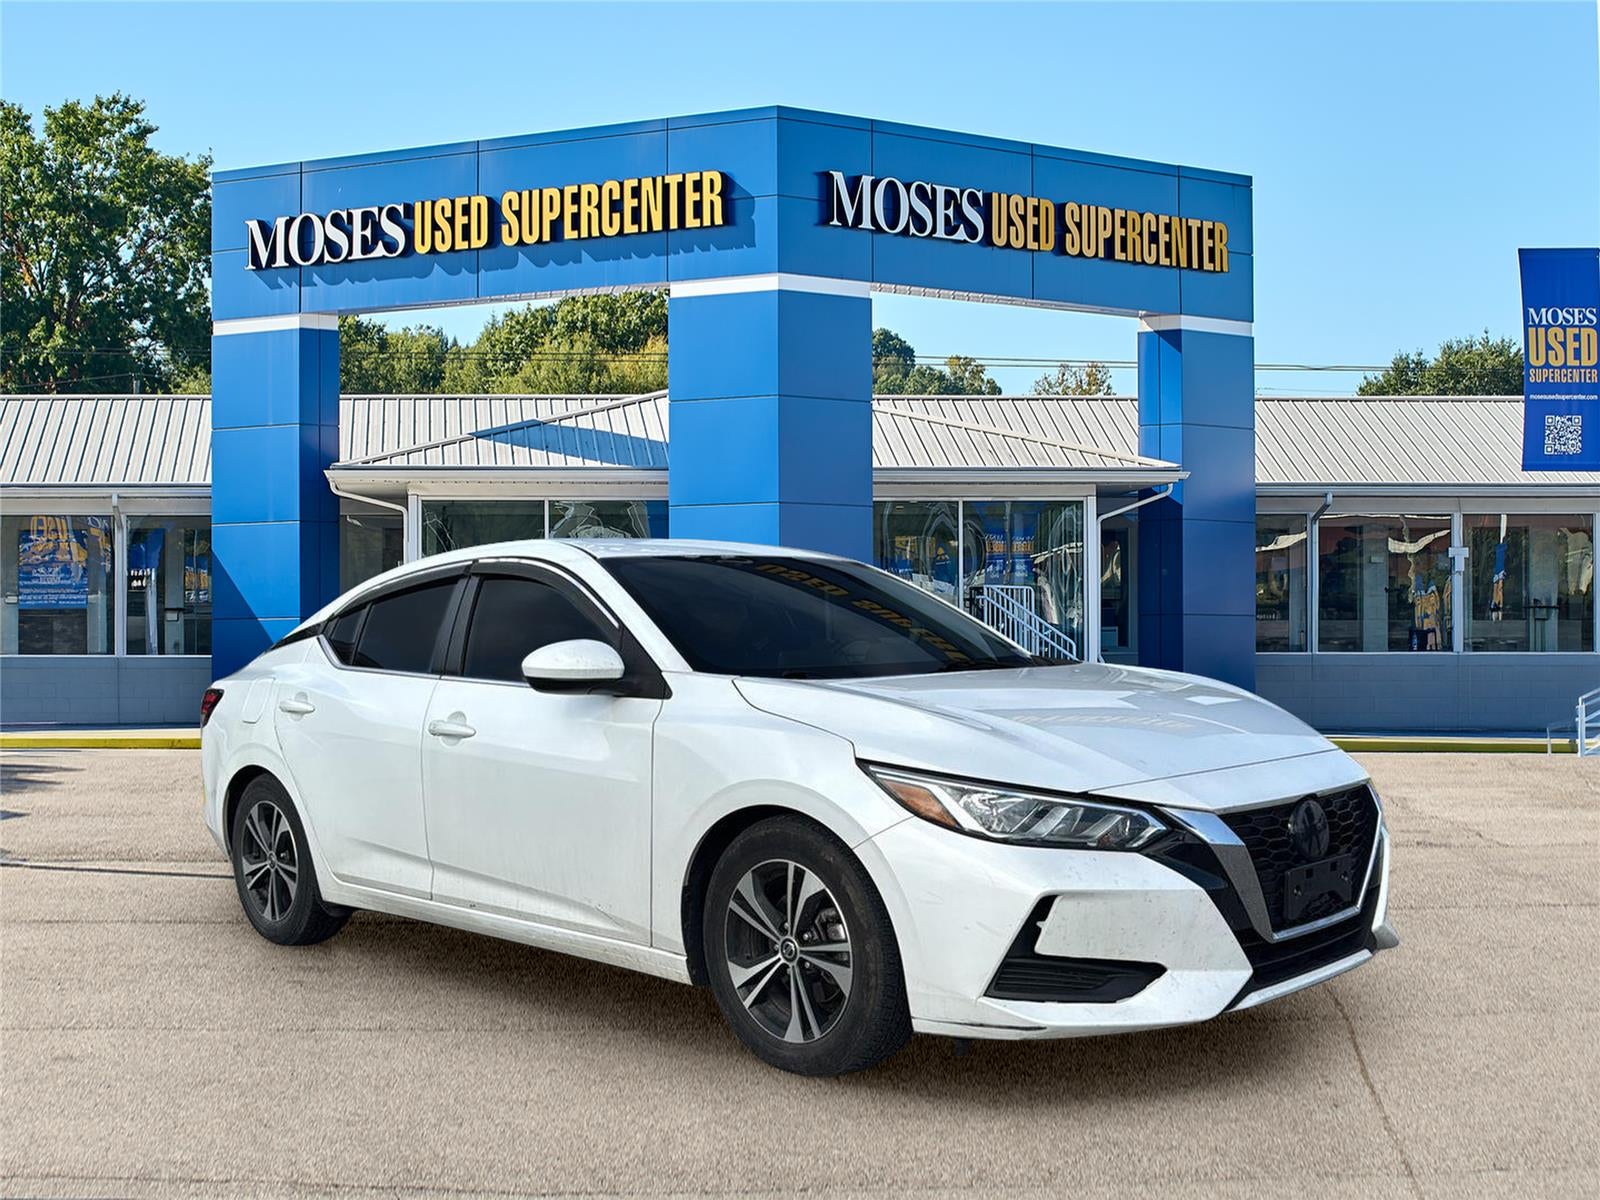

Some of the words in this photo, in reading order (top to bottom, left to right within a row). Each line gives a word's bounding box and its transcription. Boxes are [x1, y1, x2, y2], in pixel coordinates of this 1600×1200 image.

[244, 204, 407, 270] MOSES
[413, 195, 489, 255] USED
[501, 170, 724, 246] SUPERCENTER
[829, 170, 985, 243] MOSES
[991, 192, 1056, 251] USED
[1065, 202, 1230, 273] SUPERCENTER
[1527, 307, 1597, 326] MOSES
[1528, 327, 1598, 367] USED
[1529, 368, 1598, 383] SUPERCENTER
